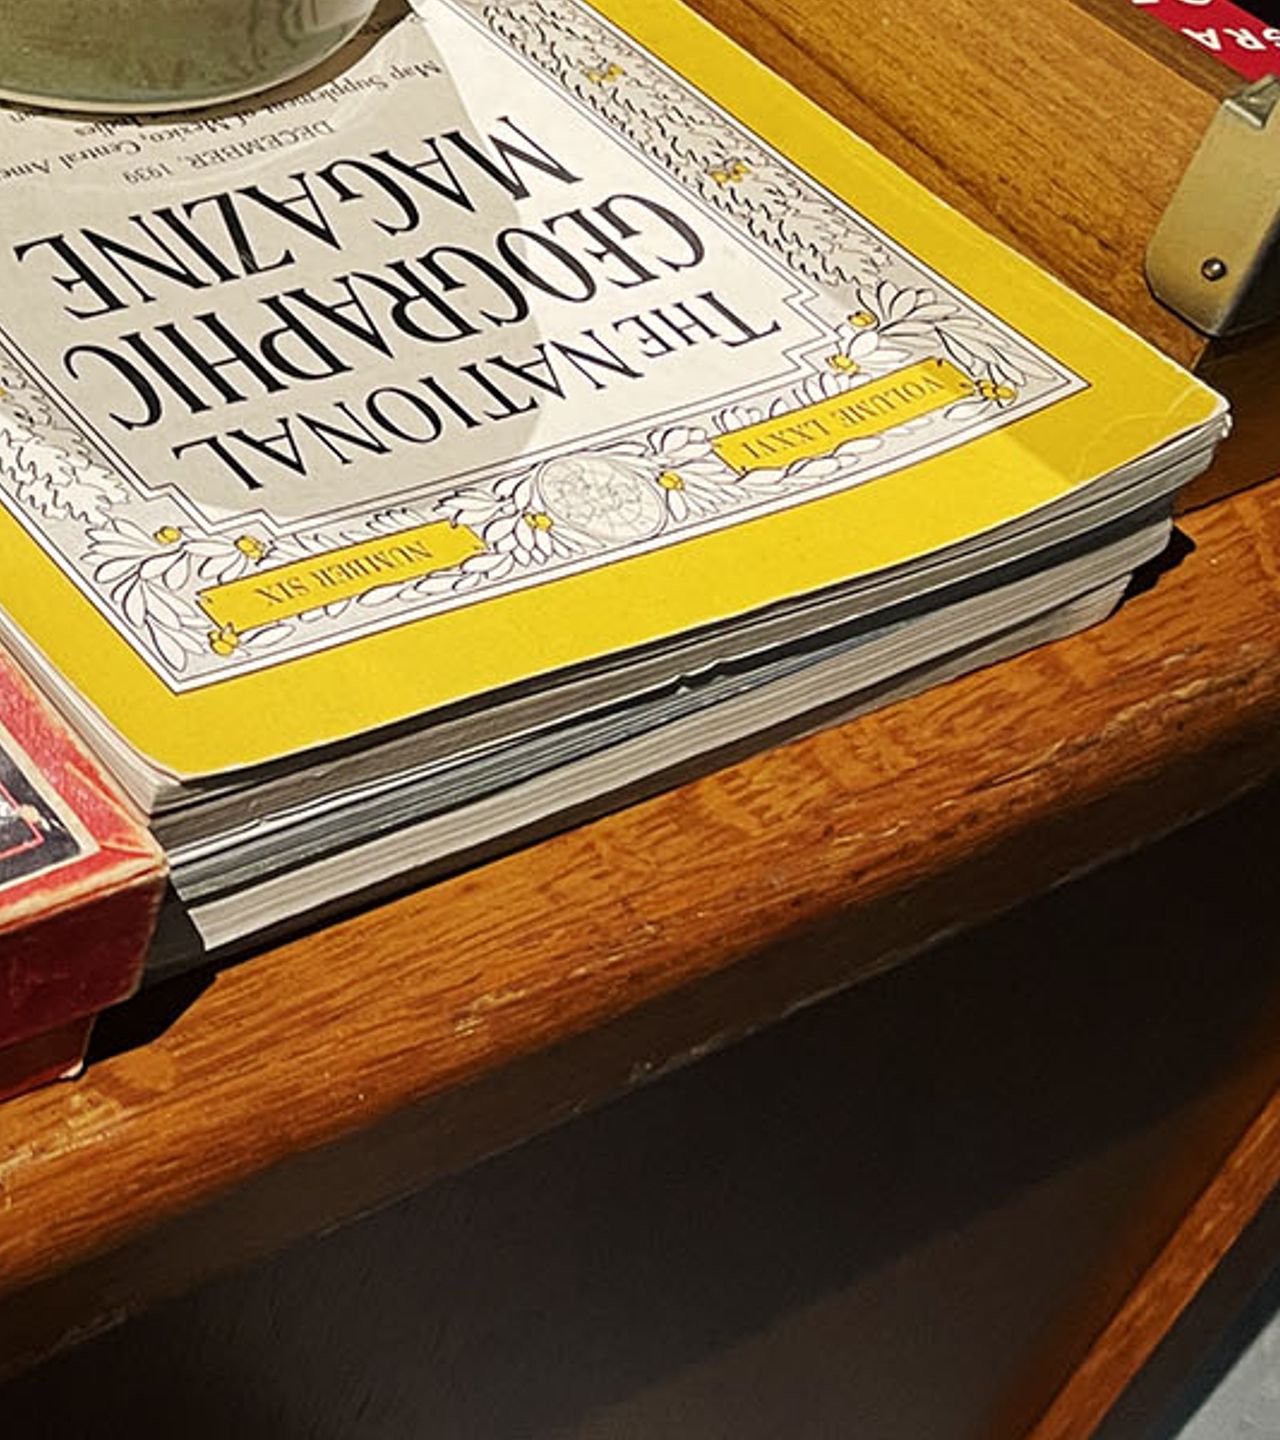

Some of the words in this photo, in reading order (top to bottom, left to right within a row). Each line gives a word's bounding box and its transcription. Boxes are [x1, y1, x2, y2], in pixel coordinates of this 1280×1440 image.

[388, 59, 443, 82] Map
[260, 76, 389, 118] Supplement
[58, 137, 142, 171] Central
[140, 113, 232, 147] Mexico,
[176, 119, 336, 171] DECEMBER,
[121, 161, 173, 185] 1939
[12, 114, 582, 321] MAGAZINE
[62, 192, 707, 432] GEOGRAPHIC
[611, 288, 781, 359] THE
[171, 327, 646, 492] NATIONAL
[838, 371, 940, 428] VOLUME
[739, 412, 831, 463] LXXVI
[253, 572, 303, 608] SIX
[308, 538, 438, 591] NUMBER
